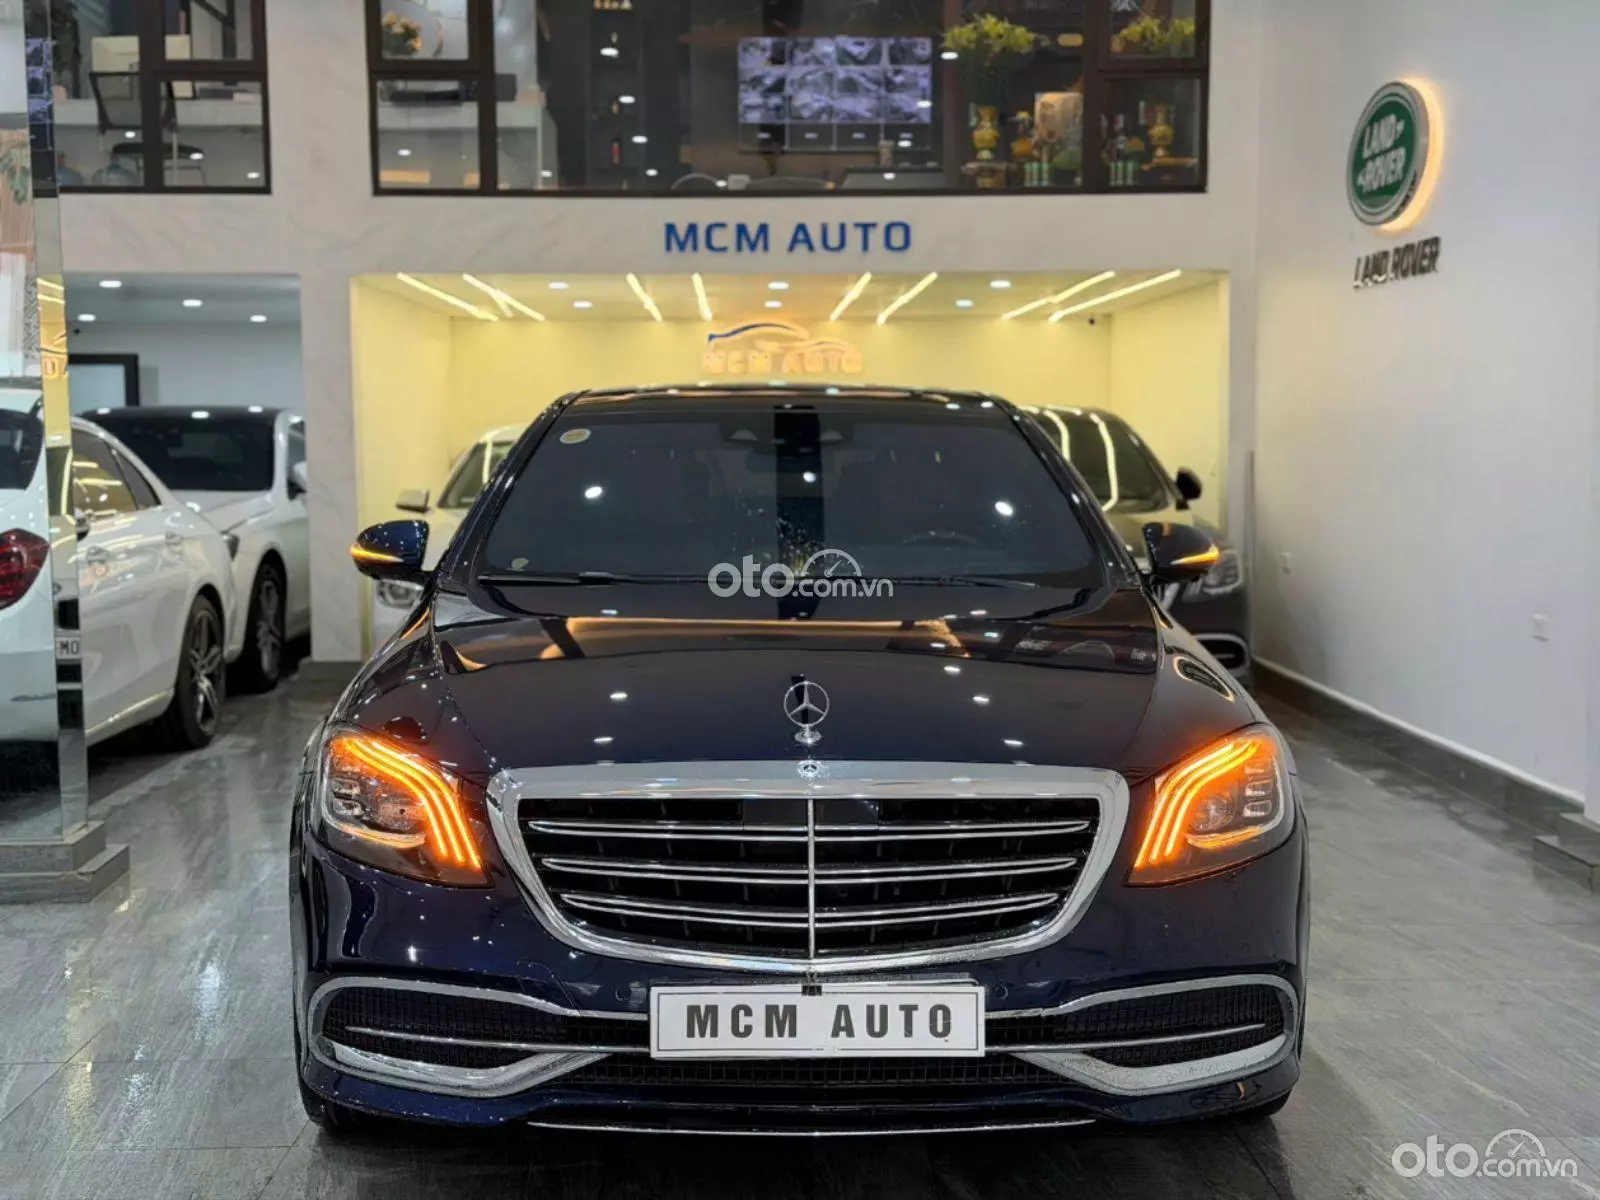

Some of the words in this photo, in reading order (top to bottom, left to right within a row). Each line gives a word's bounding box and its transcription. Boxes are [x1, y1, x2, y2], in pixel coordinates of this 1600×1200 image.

[664, 222, 770, 252] MCM
[787, 221, 912, 253] AUTO
[1353, 250, 1390, 290] LAND
[1391, 236, 1441, 281] ROVER
[782, 350, 863, 374] AUTO
[686, 1004, 797, 1039] MCM
[831, 1004, 953, 1039] AUTO
